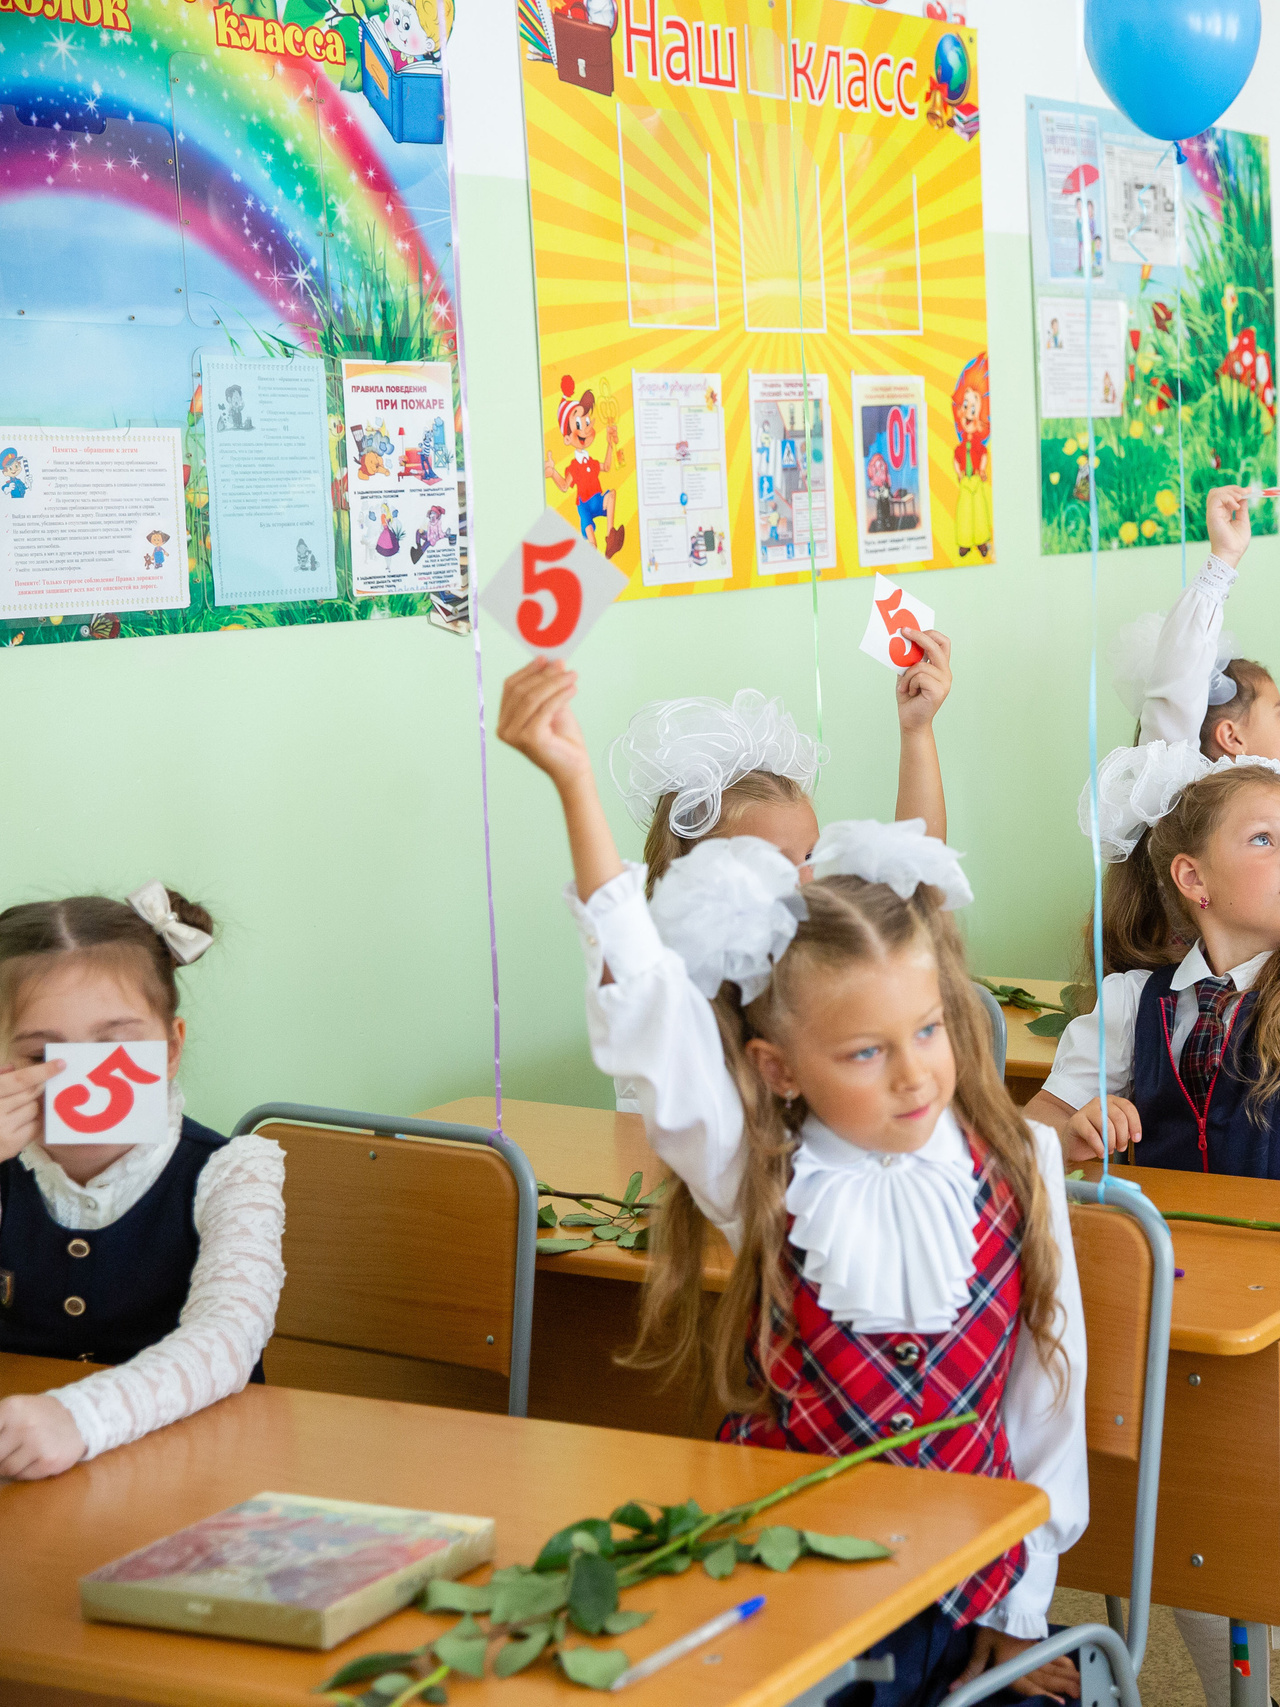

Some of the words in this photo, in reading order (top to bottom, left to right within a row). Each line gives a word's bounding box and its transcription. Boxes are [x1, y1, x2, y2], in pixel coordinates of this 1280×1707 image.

[214, 2, 347, 66] класса
[624, 0, 738, 92] Наш
[790, 39, 918, 118] класс
[351, 385, 384, 393] ПРАВИЛА
[385, 385, 427, 394] ПОВЕДЕНИЯ
[376, 399, 398, 410] ПРИ
[401, 399, 444, 410] ПОЖАРЕ
[889, 408, 917, 468] 01
[516, 537, 583, 648] 5
[875, 588, 925, 668] 5
[53, 1045, 161, 1133] 5
